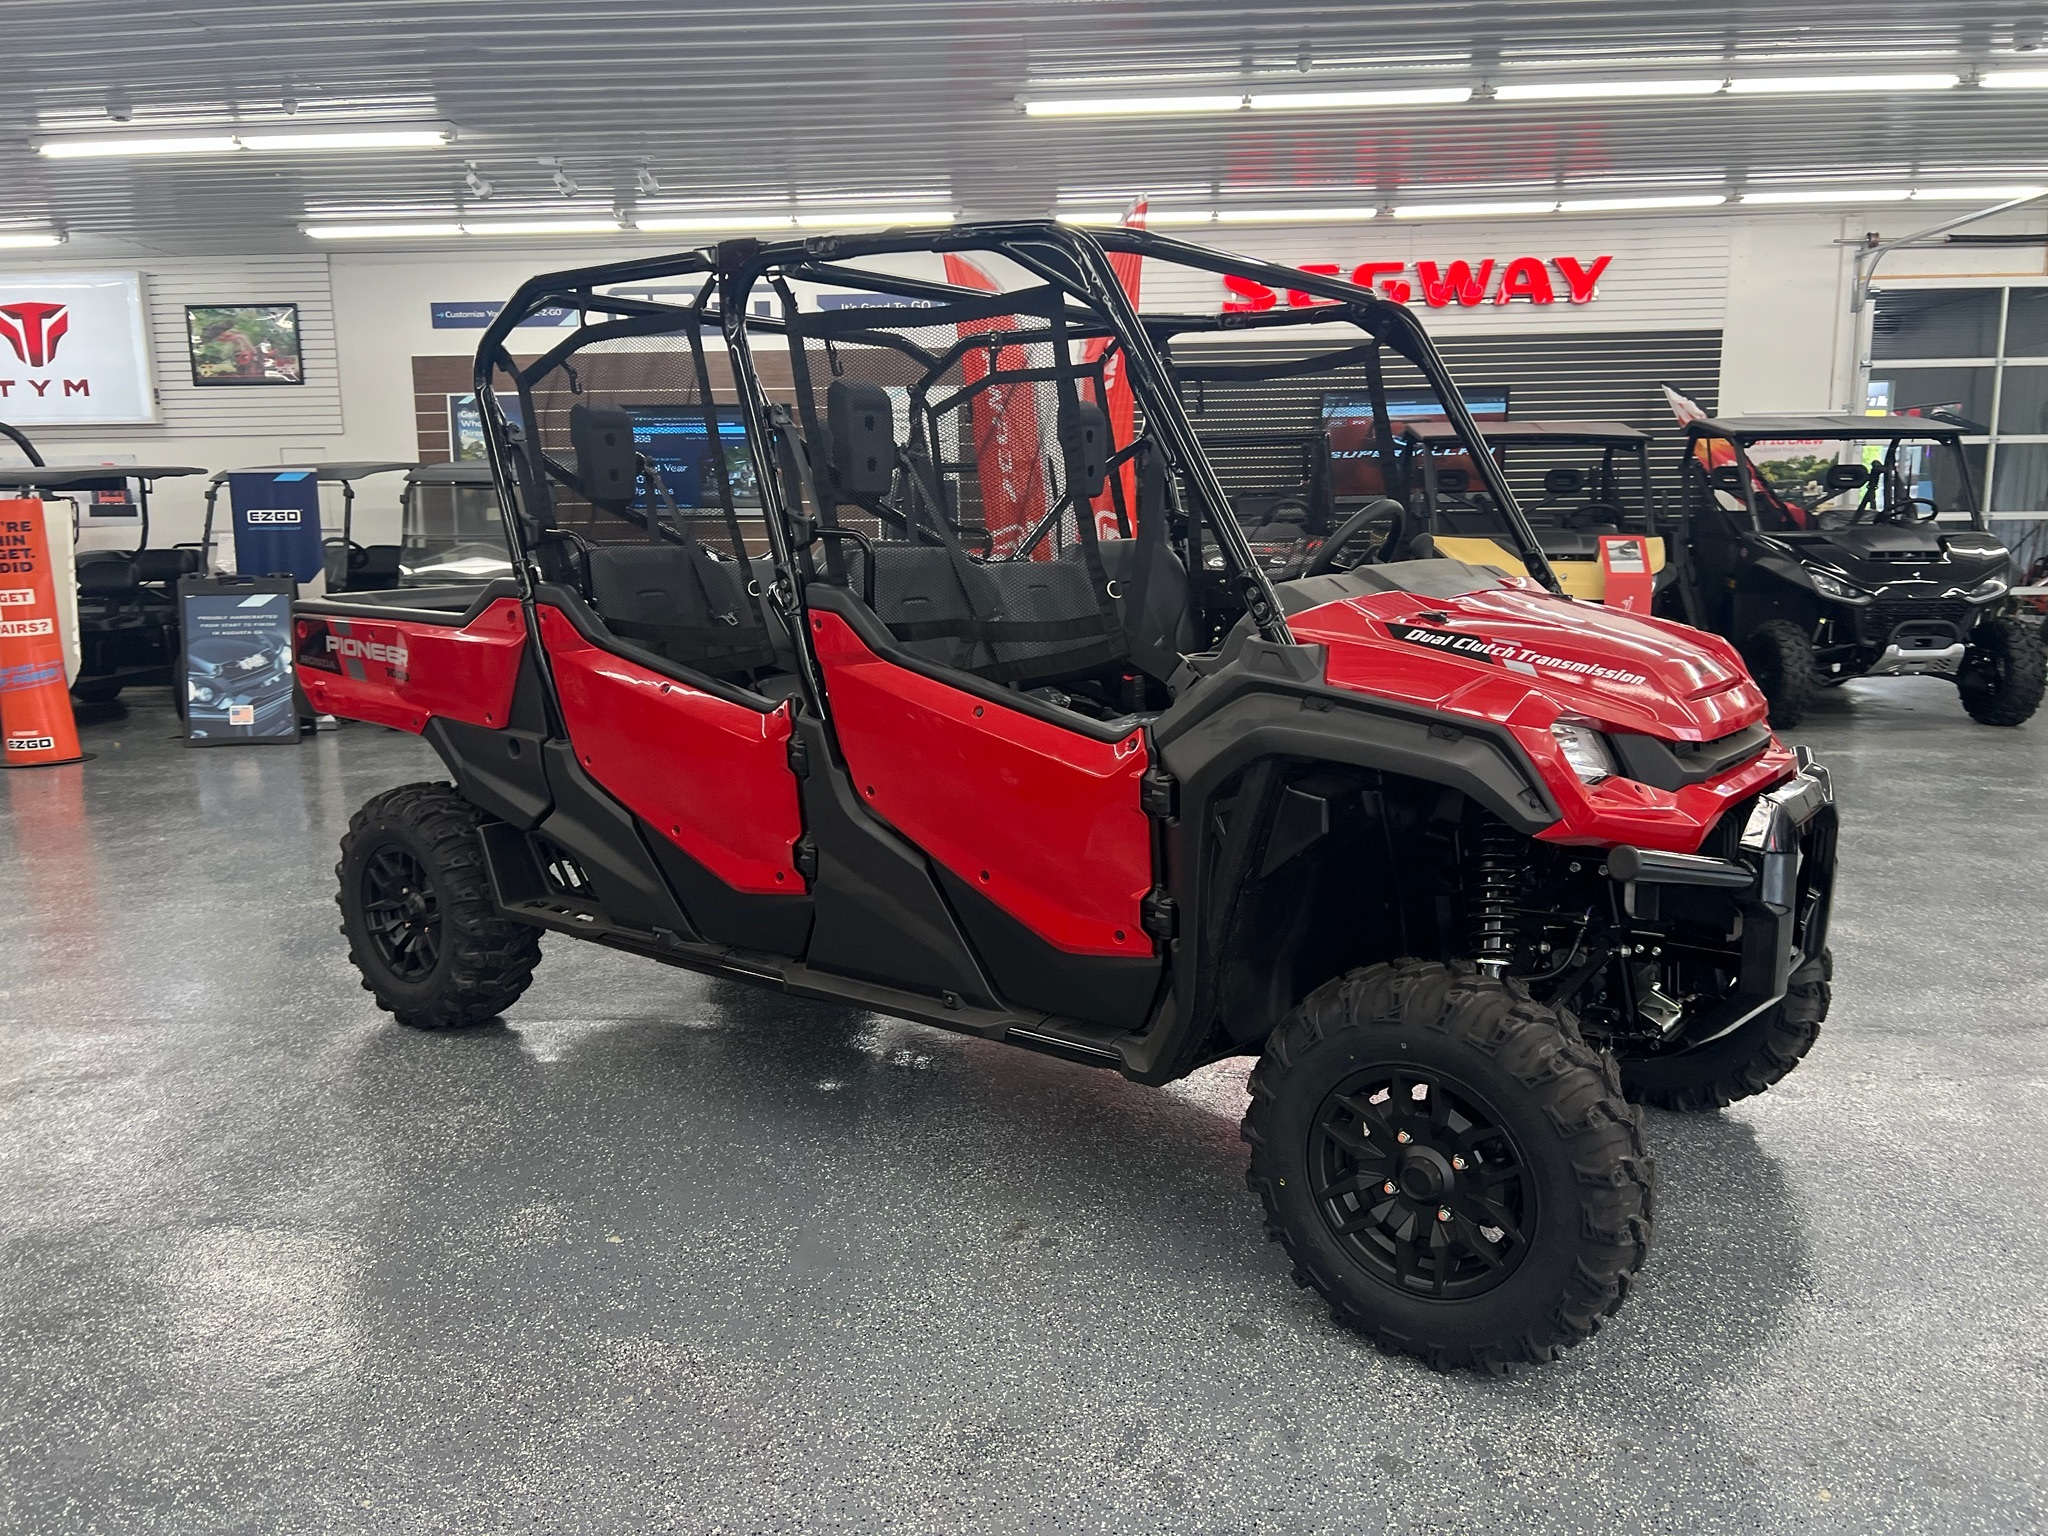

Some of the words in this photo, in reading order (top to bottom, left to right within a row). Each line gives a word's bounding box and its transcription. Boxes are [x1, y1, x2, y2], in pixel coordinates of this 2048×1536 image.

[1222, 255, 1614, 312] SEGWAY
[0, 379, 90, 397] TYM
[326, 635, 408, 668] PIONEER
[1404, 629, 1451, 646] Dual
[1452, 636, 1517, 658] Clutch
[1517, 649, 1647, 685] Transmission
